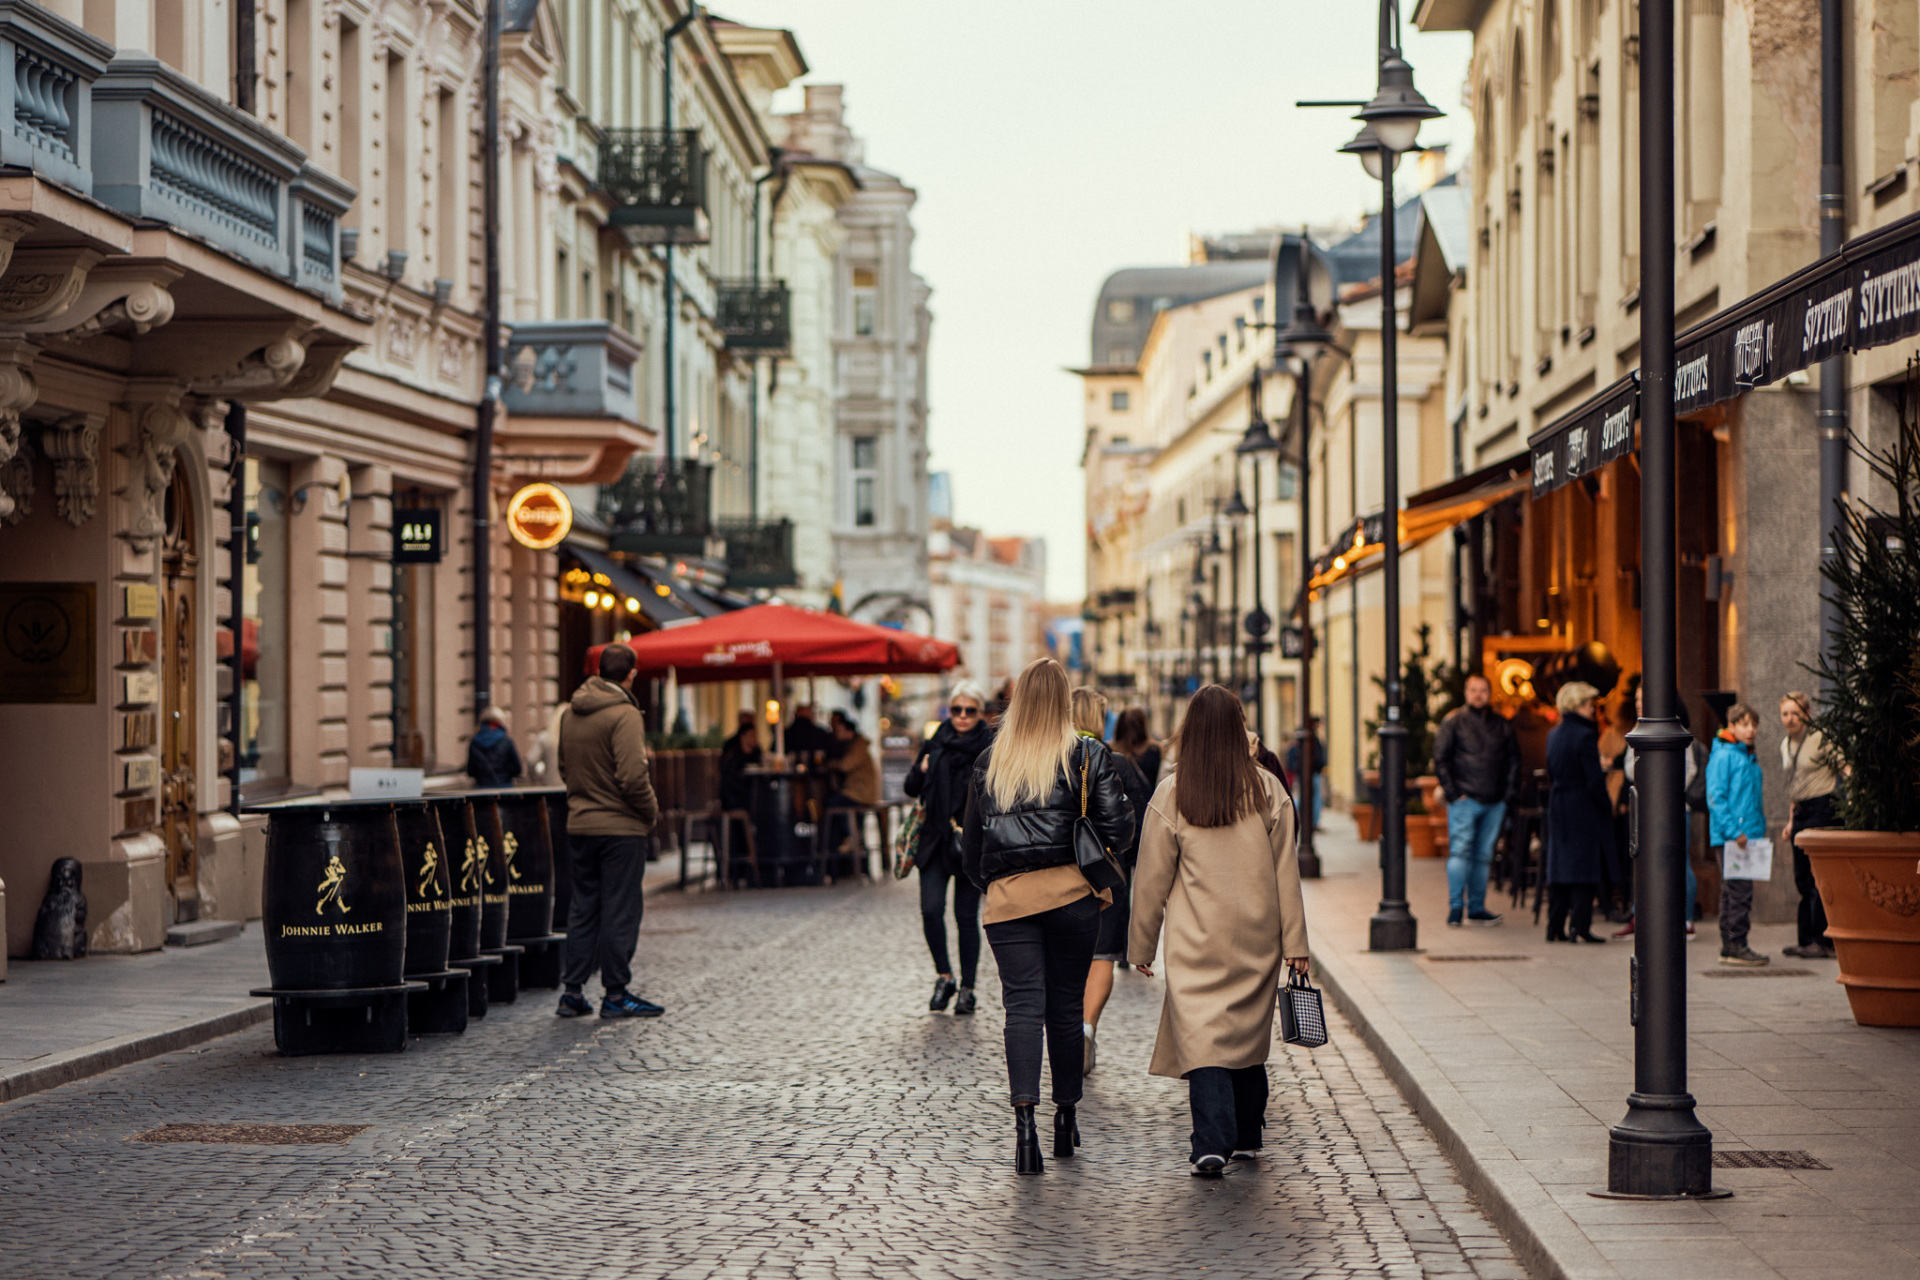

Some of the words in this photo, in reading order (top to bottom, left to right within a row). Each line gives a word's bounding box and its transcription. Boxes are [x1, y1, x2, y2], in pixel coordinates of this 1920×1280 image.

[1802, 287, 1853, 352] ŠVYTURY
[401, 523, 432, 541] ALI
[407, 902, 432, 912] NNIE
[281, 924, 331, 938] JOHNNIE
[335, 922, 383, 935] WALKER
